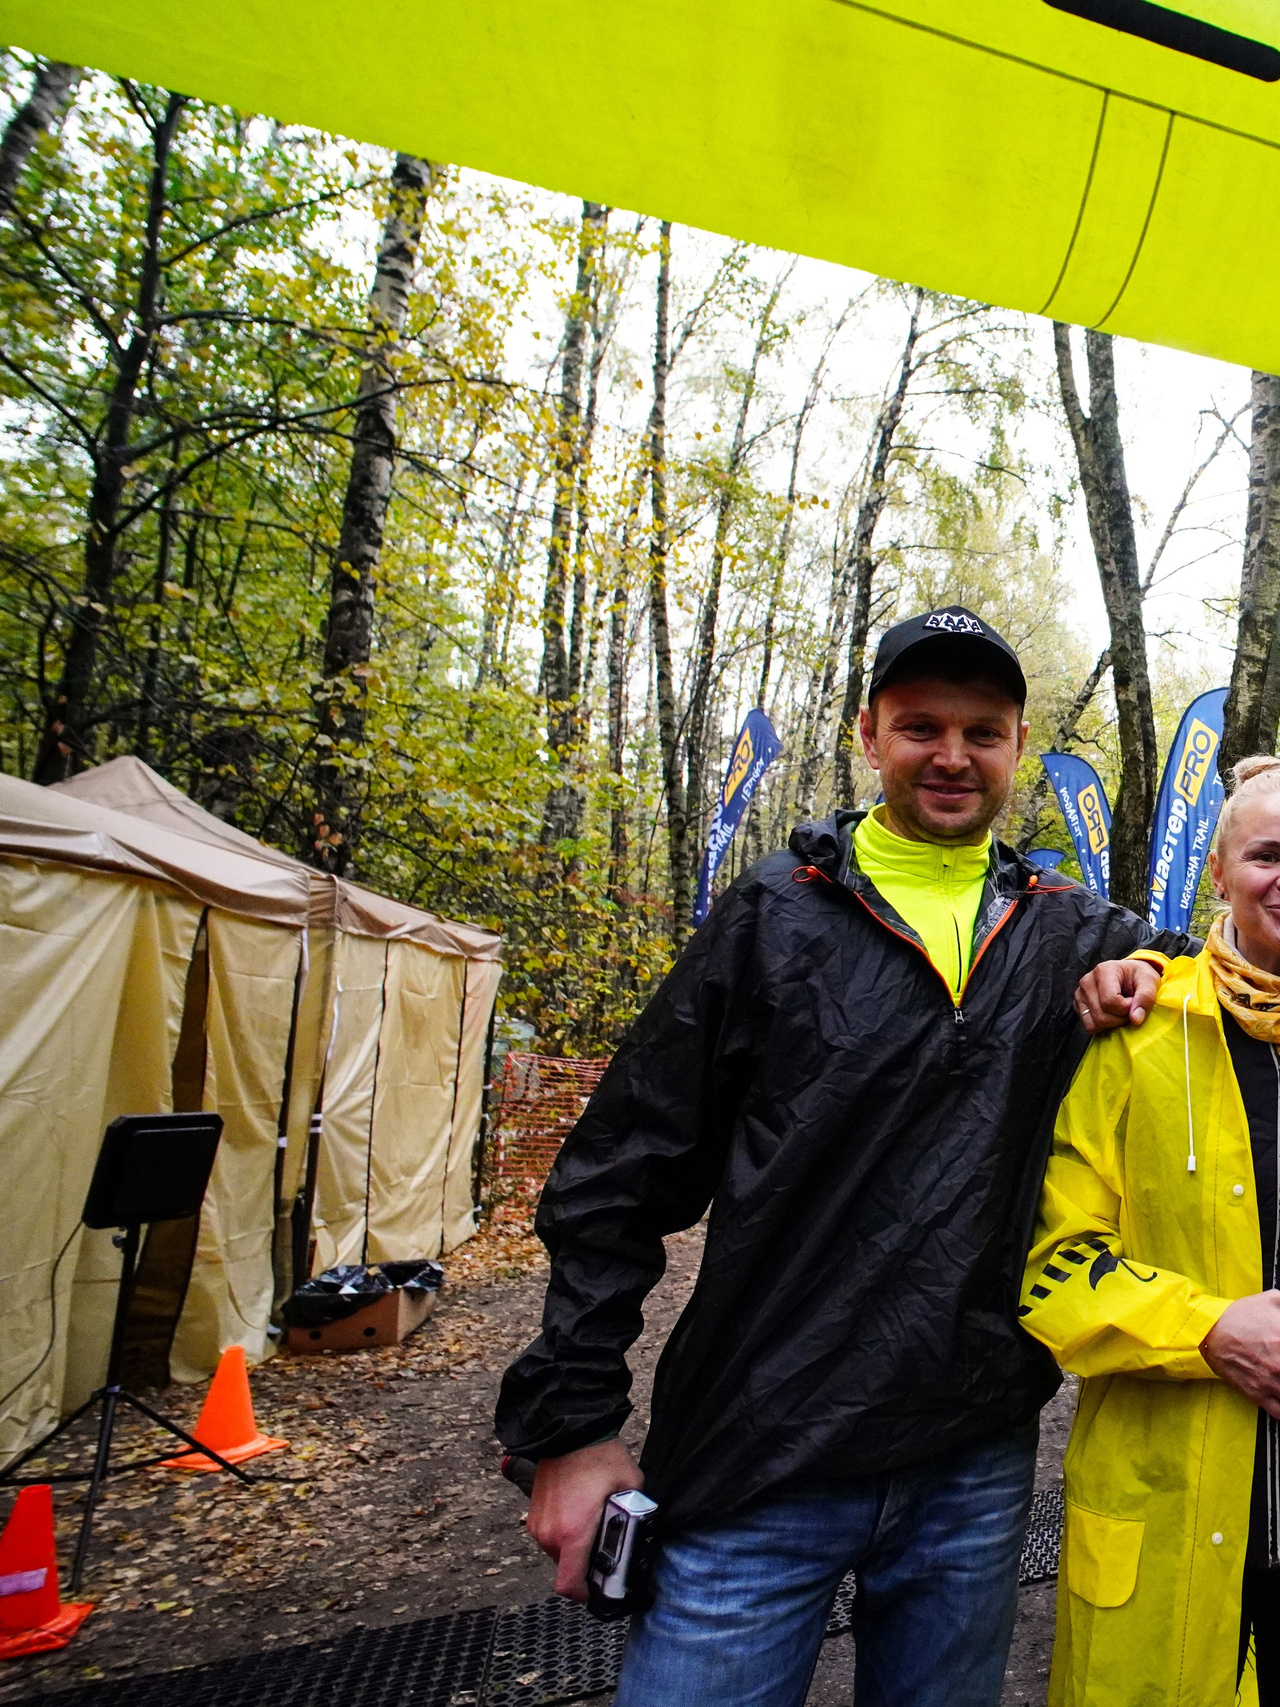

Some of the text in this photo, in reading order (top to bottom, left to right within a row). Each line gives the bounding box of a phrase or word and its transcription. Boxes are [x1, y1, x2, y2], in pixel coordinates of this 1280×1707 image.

[1179, 729, 1211, 799] PRO
[1180, 817, 1210, 910] UGRESHA TRAIL
